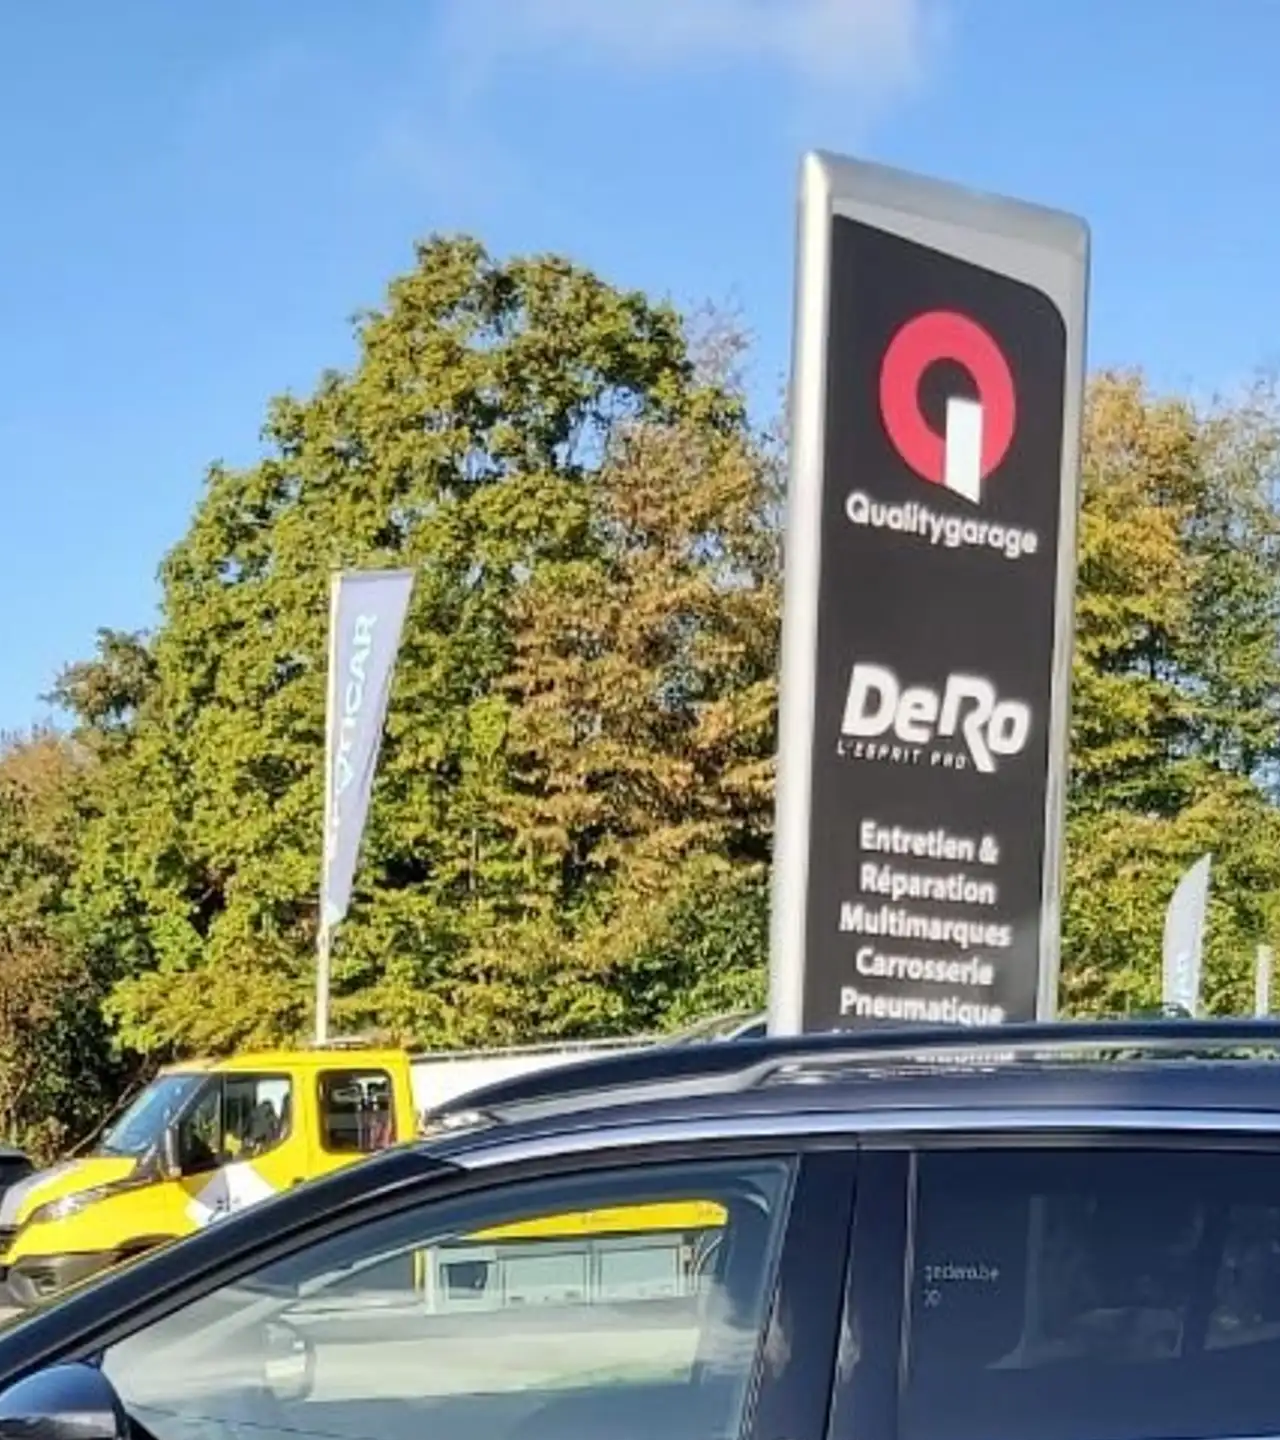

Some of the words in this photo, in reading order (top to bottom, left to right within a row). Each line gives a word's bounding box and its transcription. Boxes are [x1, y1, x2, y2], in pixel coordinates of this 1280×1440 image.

[845, 491, 1038, 558] Qualitygarage
[840, 663, 1031, 774] DeRo
[930, 750, 969, 770] PRO
[859, 818, 976, 863] Entretien
[978, 834, 1001, 865] &
[859, 862, 997, 905] Réparation
[838, 901, 1013, 950] Multimarques
[855, 946, 994, 986] Carrosserie
[839, 986, 1007, 1027] Pneumatique
